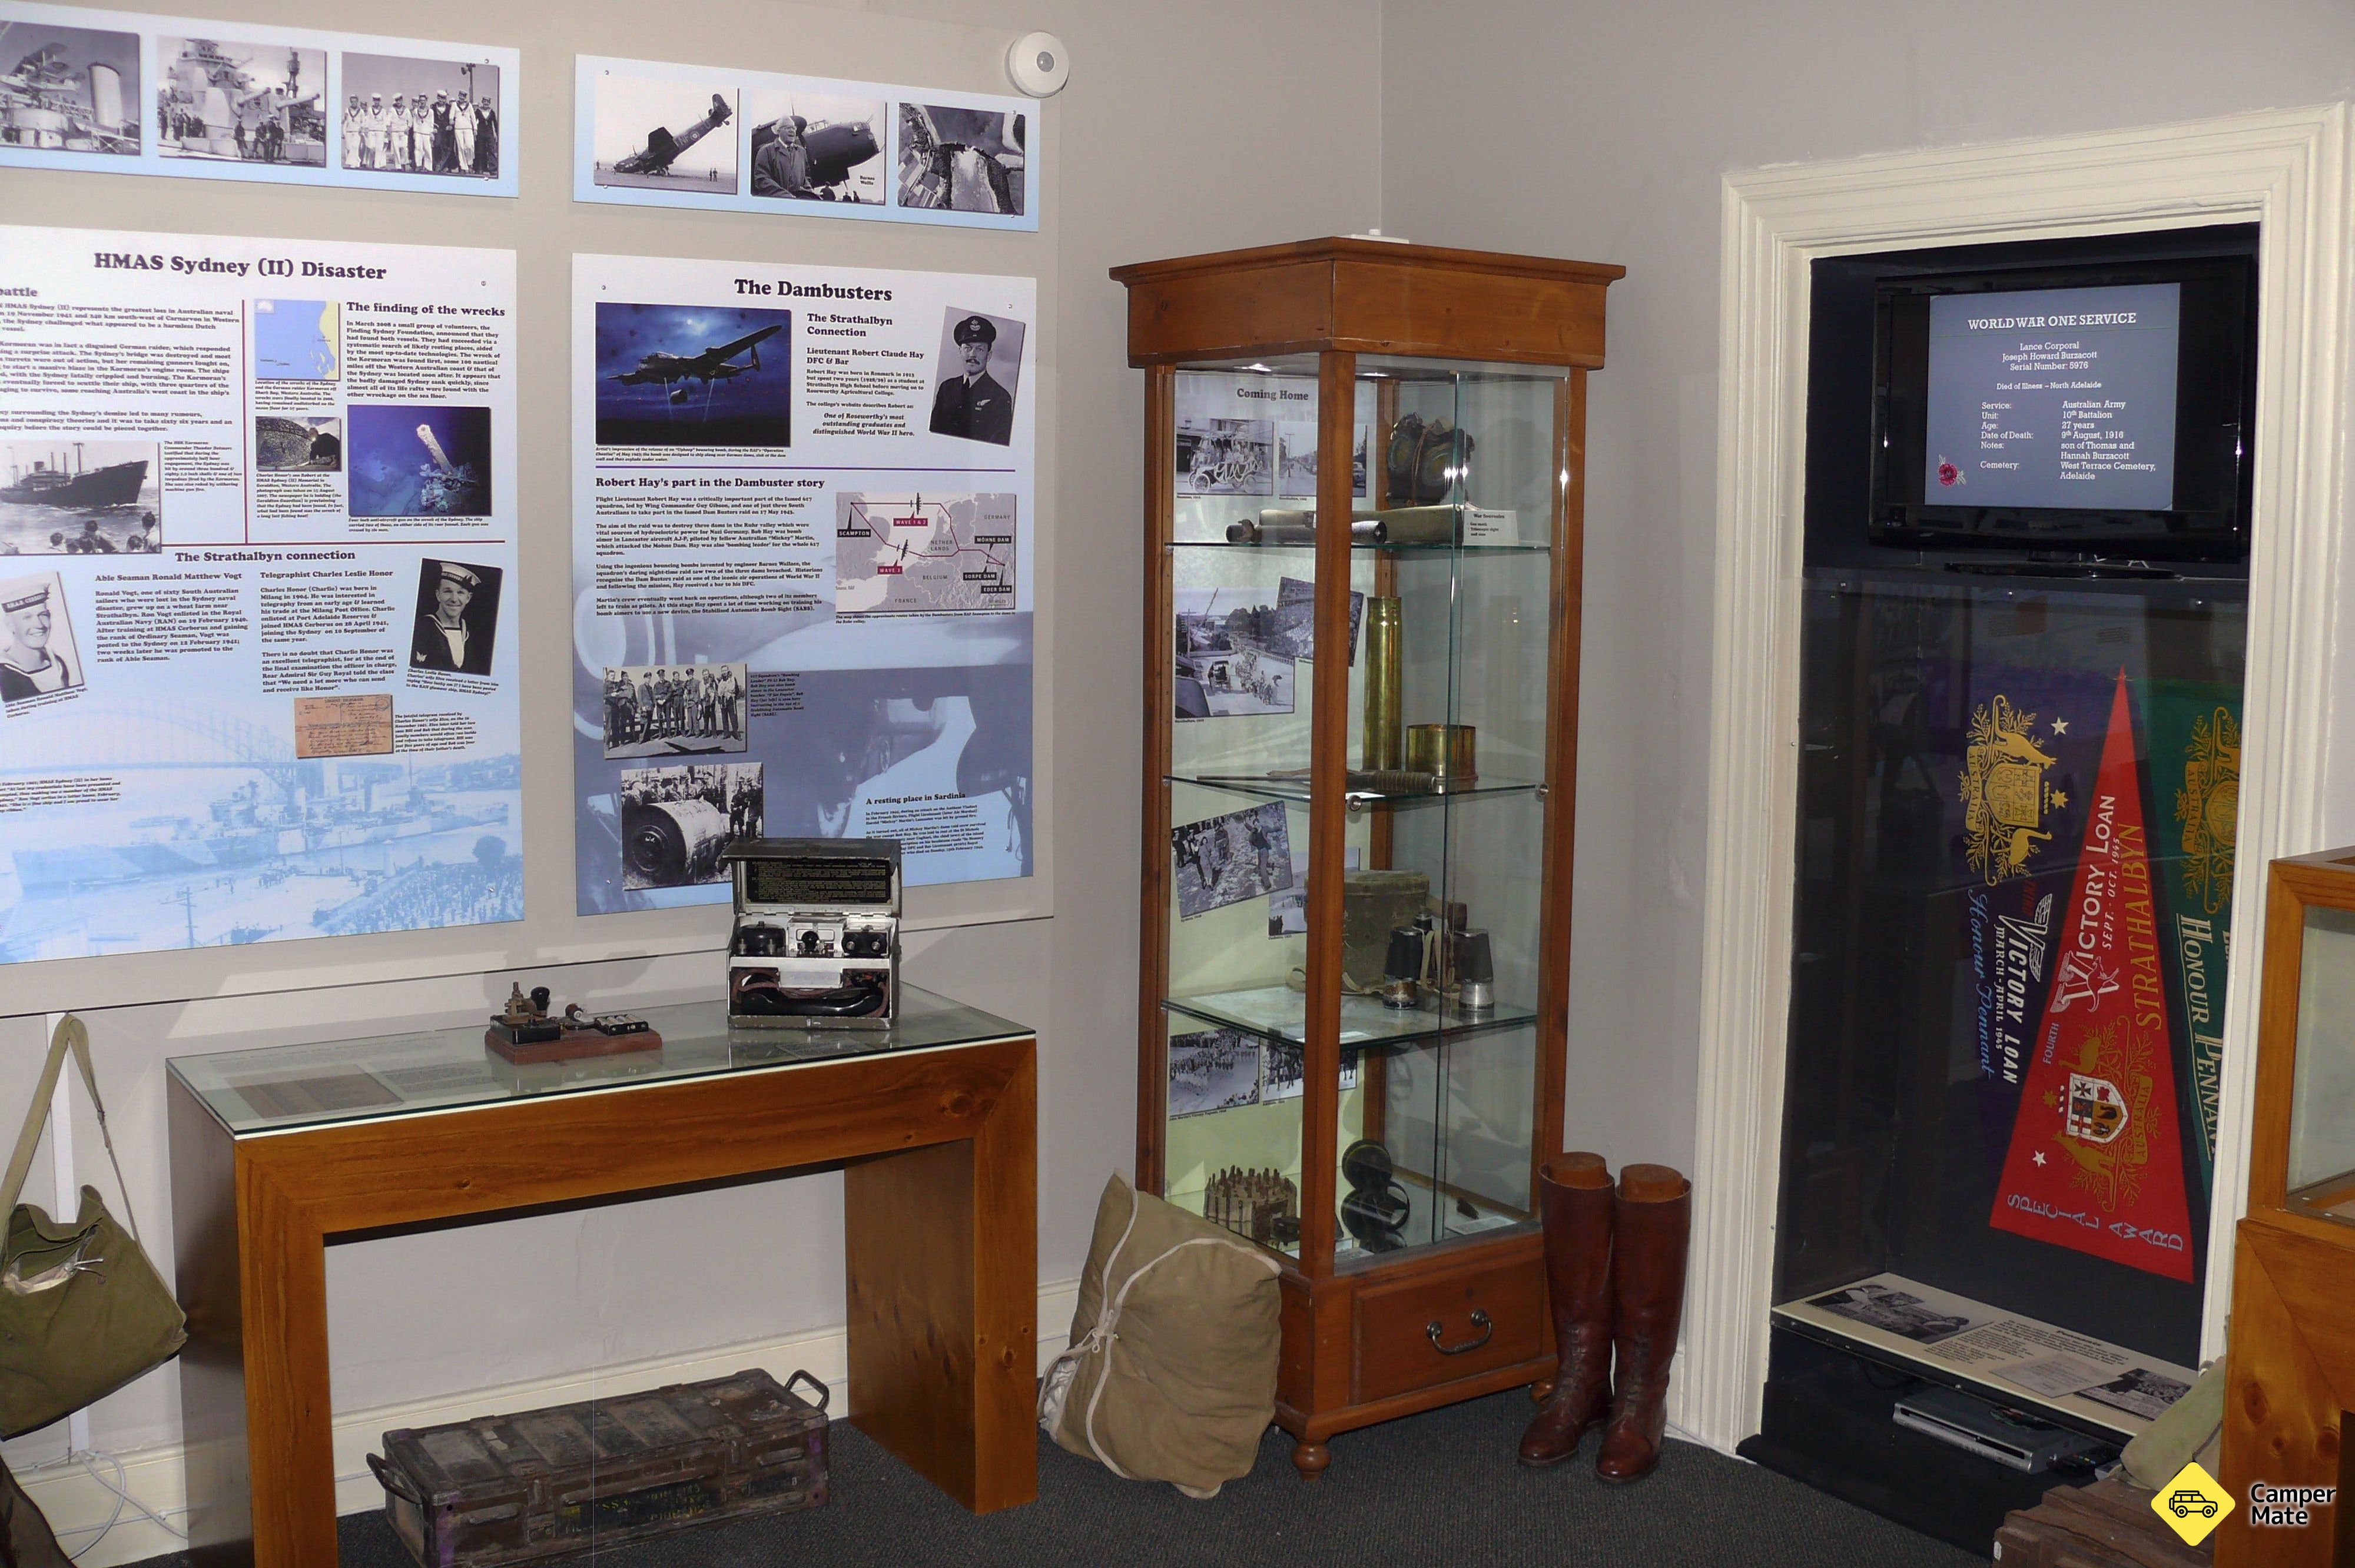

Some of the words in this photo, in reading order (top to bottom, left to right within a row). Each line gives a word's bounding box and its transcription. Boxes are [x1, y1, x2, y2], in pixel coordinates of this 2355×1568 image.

[94, 253, 163, 270] HMAS
[170, 255, 250, 277] Sydney
[258, 258, 293, 277] (II)
[301, 261, 387, 279] Disaster
[734, 278, 771, 295] The
[777, 281, 892, 301] Dambusters
[346, 301, 370, 311] The
[374, 303, 417, 315] finding
[422, 304, 433, 313] of
[437, 305, 457, 314] the
[460, 307, 505, 316] wrecks
[807, 313, 827, 322] The
[830, 314, 892, 326] Strathalbyn
[1968, 318, 2014, 330] WORLD
[2015, 317, 2045, 327] WAR
[2048, 315, 2077, 326] ONE
[2079, 313, 2136, 325] SERVICE
[807, 326, 866, 337] Connection
[2044, 341, 2079, 352] Corporal
[909, 351, 924, 359] Hay
[2002, 353, 2028, 363] Joseph
[2029, 350, 2061, 360] Howard
[2061, 351, 2097, 359] Burzacott
[2010, 361, 2031, 370] Serial
[2034, 362, 2068, 370] Number:
[2069, 361, 2088, 369] 5976
[1236, 388, 1276, 401] Coming
[1279, 390, 1308, 400] Home
[2103, 400, 2126, 409] Army
[2078, 410, 2112, 418] Battalion
[1981, 421, 1998, 431] Age:
[2072, 431, 2101, 440] August,
[2077, 441, 2085, 449] of
[2085, 441, 2117, 449] Thomas
[2092, 451, 2129, 460] Burzacott
[1980, 461, 2019, 470] Cemetery:
[2114, 461, 2155, 471] Cemetery,
[2059, 471, 2095, 480] Adelaide
[596, 477, 635, 486] Robert
[639, 477, 668, 488] Hay's
[671, 479, 696, 488] part
[699, 478, 710, 486] in
[713, 478, 731, 486] the
[735, 478, 794, 487] Dambuster
[797, 479, 825, 489] story
[174, 552, 200, 562] The
[203, 551, 282, 562] Strathalbyn
[286, 550, 355, 560] connection
[260, 571, 310, 579] Telegraphist
[2086, 795, 2115, 853] LOAN
[2111, 837, 2120, 864] 1945
[1968, 888, 1988, 978] Honour
[2118, 823, 2161, 1030] STRATHALBYN
[2055, 864, 2120, 1008] VICTORY
[1998, 915, 2048, 1024] VICTORY
[2180, 915, 2213, 1024] HONOUR
[1976, 983, 1995, 1079] Pennant
[2043, 1023, 2059, 1064] FOURTH
[2002, 1034, 2021, 1084] LOAN
[2008, 1194, 2100, 1229] SPECIAL
[2109, 1221, 2183, 1251] AWARD
